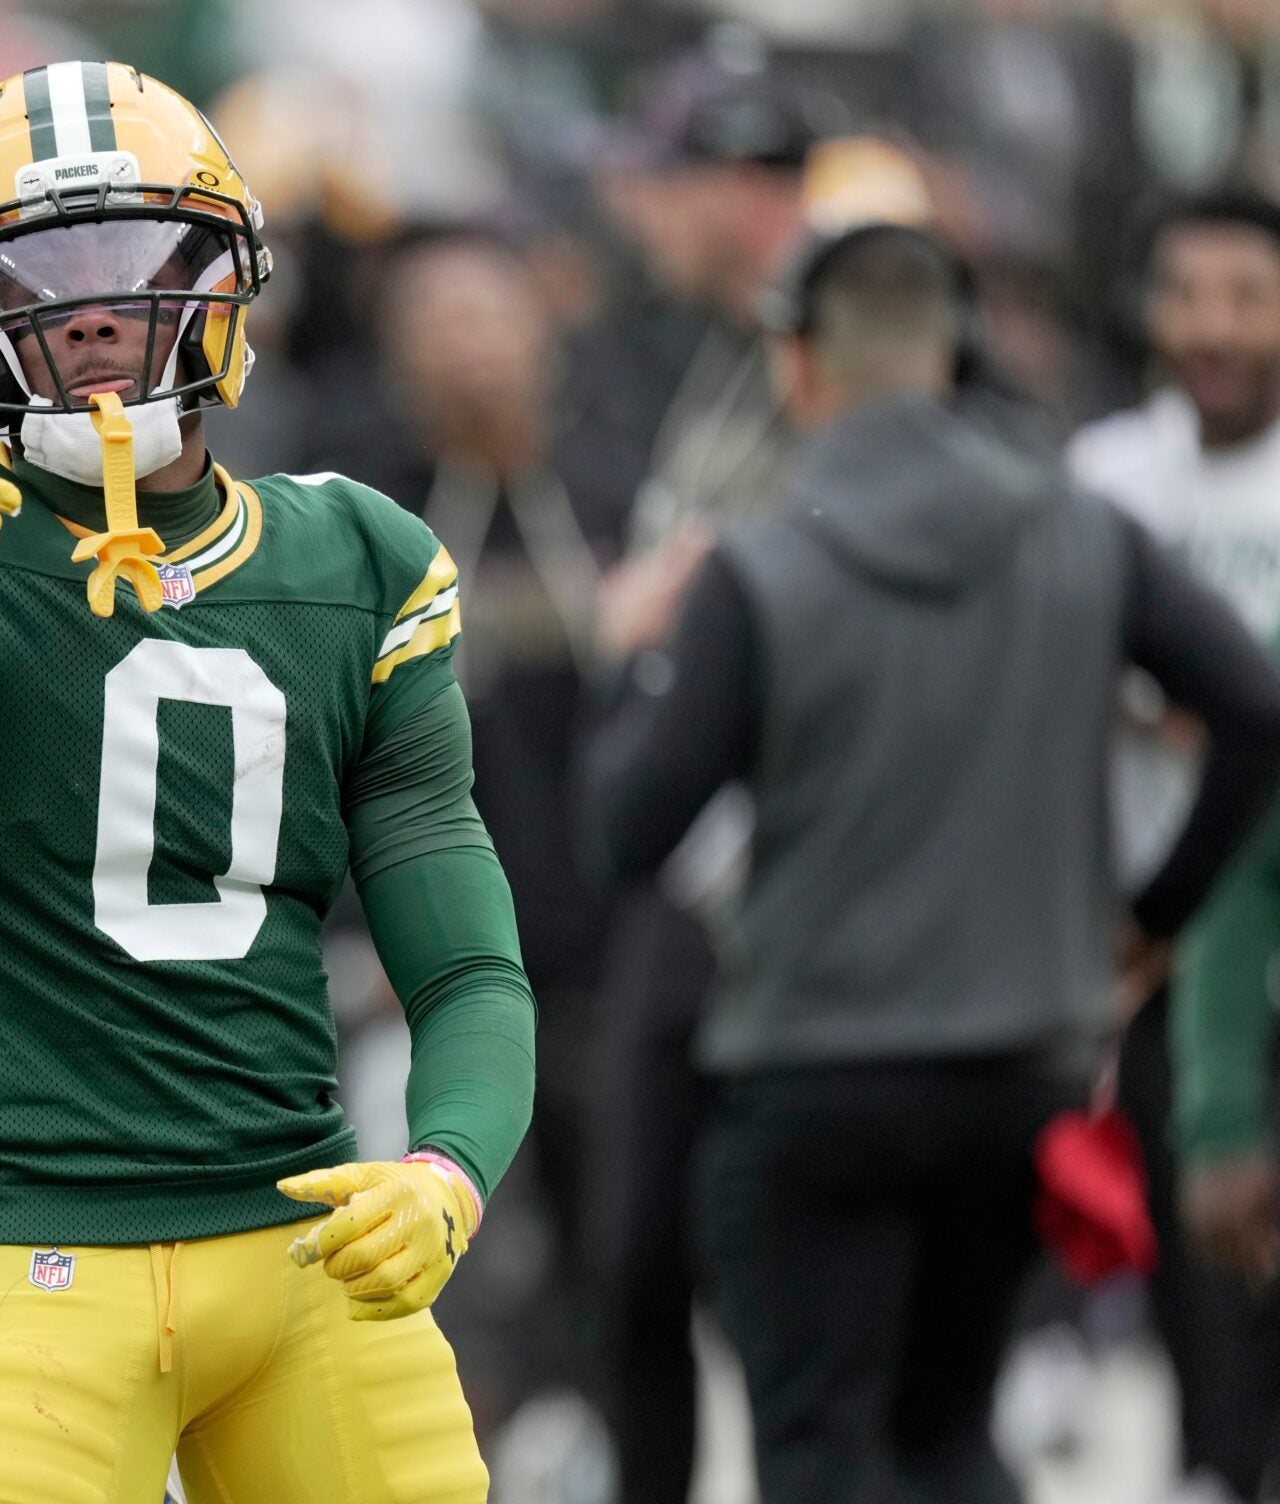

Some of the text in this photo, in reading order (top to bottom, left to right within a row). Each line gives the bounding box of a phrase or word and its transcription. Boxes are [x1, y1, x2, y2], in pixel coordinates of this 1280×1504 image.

[55, 164, 99, 181] PACKERS
[161, 580, 190, 600] NFL
[92, 637, 287, 962] 0
[36, 1264, 66, 1285] NFL
